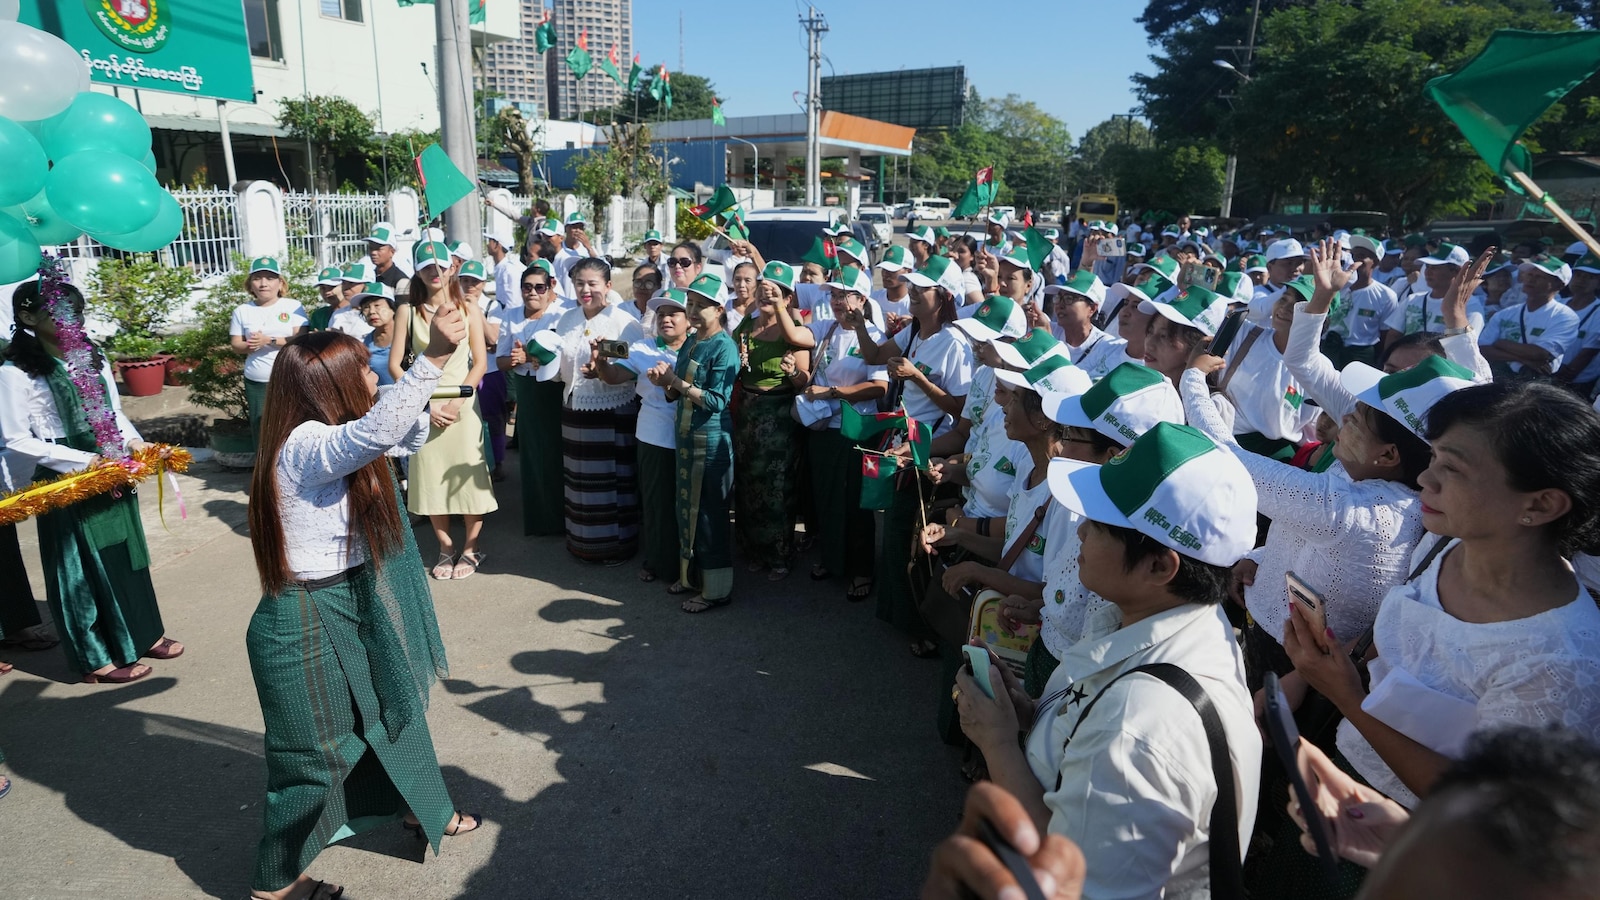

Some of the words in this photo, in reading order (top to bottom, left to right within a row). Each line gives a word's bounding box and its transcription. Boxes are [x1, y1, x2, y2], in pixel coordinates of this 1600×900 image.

[81, 48, 203, 91] န်ကုန်တိုင်းဒေသကြီး
